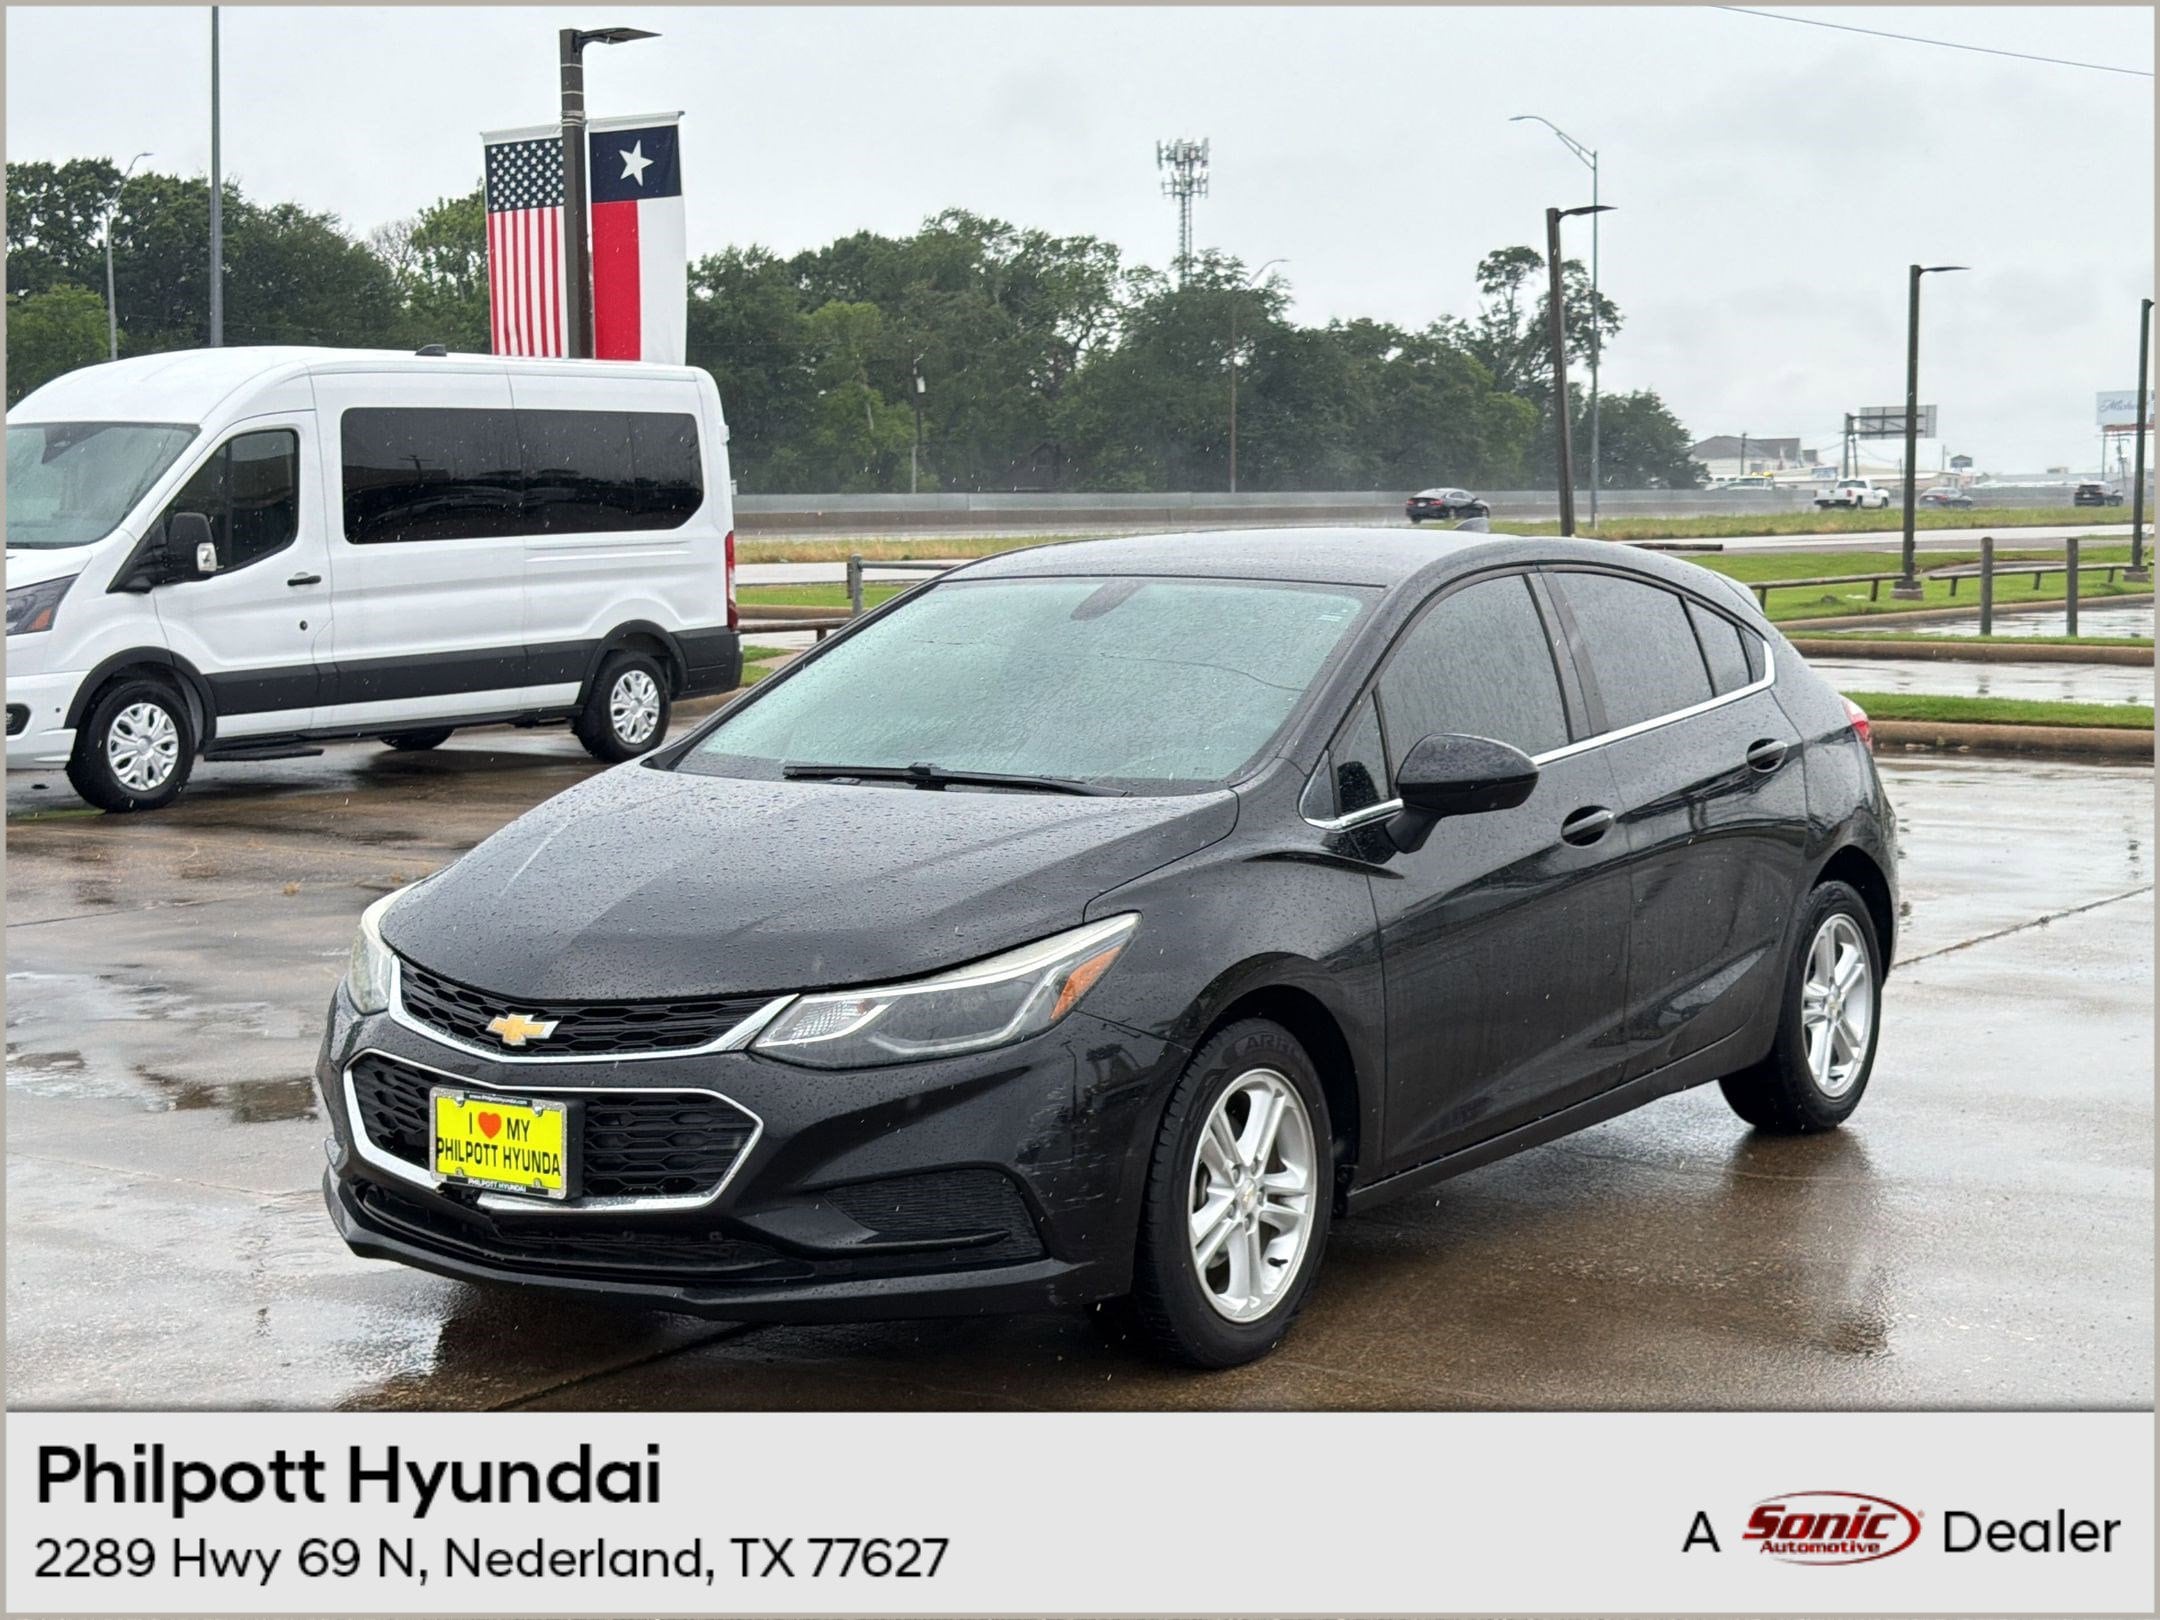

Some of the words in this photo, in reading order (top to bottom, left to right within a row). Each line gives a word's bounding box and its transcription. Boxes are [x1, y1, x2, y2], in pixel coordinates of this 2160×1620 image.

[469, 1112, 472, 1134] I
[507, 1117, 530, 1142] MY
[436, 1137, 498, 1167] PHILPOTT
